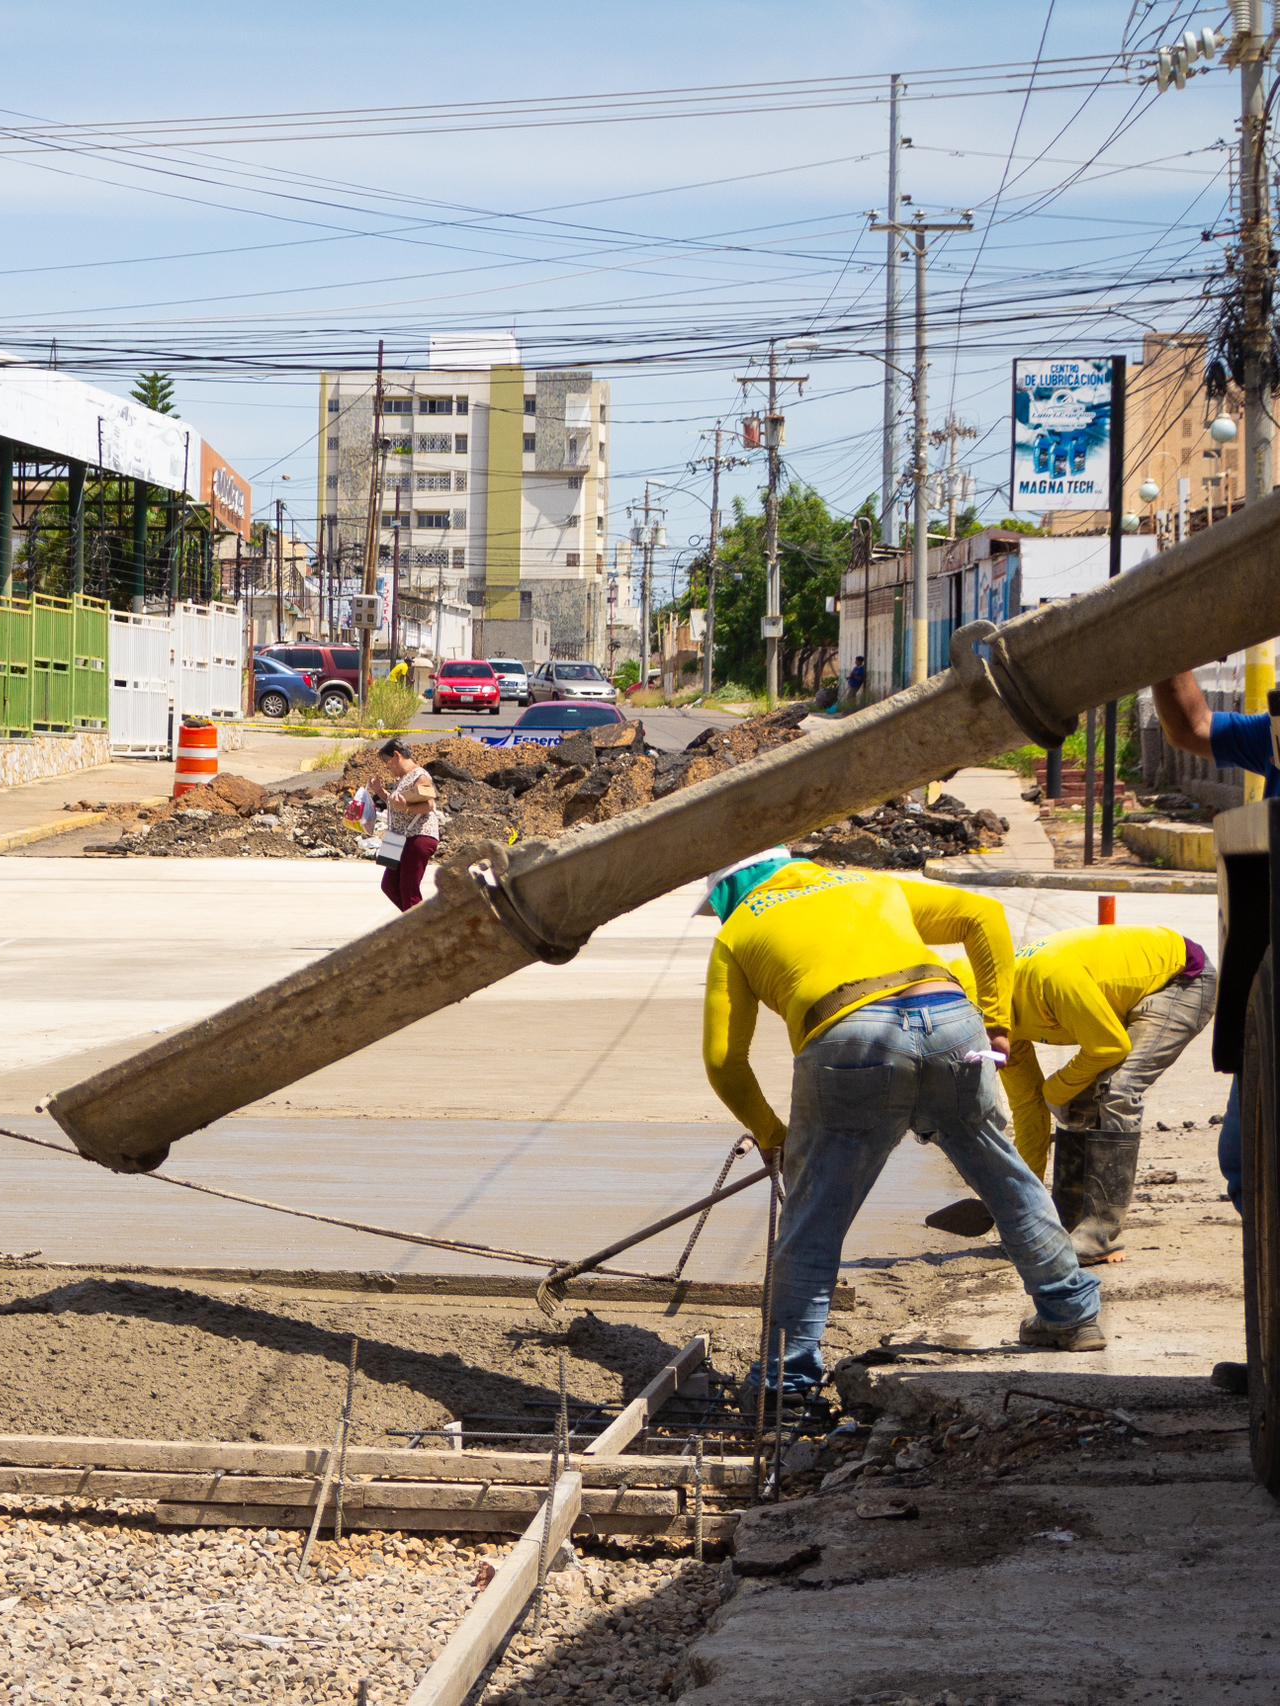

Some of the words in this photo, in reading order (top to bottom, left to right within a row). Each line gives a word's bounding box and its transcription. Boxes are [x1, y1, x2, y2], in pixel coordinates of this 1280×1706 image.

[1050, 364, 1080, 374] CENTRO
[1024, 374, 1036, 386] DE
[1019, 480, 1064, 494] MAGNA
[1066, 480, 1094, 494] TECH
